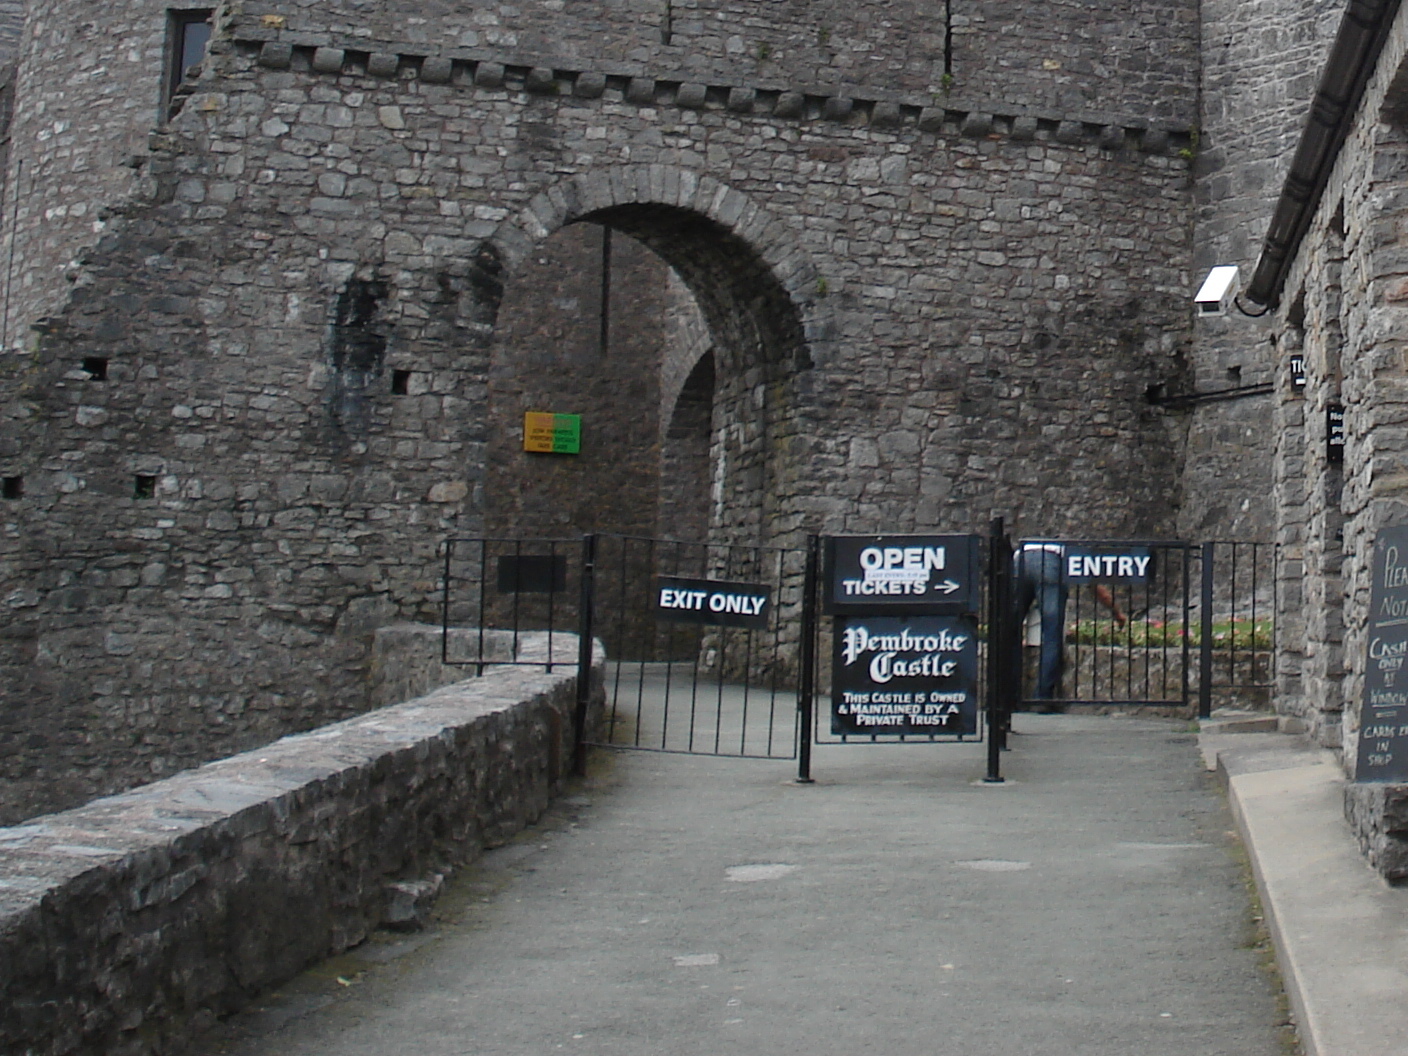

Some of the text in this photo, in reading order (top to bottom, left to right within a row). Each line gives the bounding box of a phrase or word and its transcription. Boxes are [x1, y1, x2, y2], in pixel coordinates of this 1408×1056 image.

[859, 547, 945, 570] OPEN
[1068, 556, 1151, 576] ENTRY
[842, 580, 927, 595] TICKETS
[660, 589, 765, 615] EXIT ONLY
[841, 626, 968, 666] Pembroke
[869, 651, 957, 683] Castle
[915, 692, 925, 703] IS
[838, 705, 848, 715] &
[925, 704, 943, 714] BY
[947, 705, 959, 714] A
